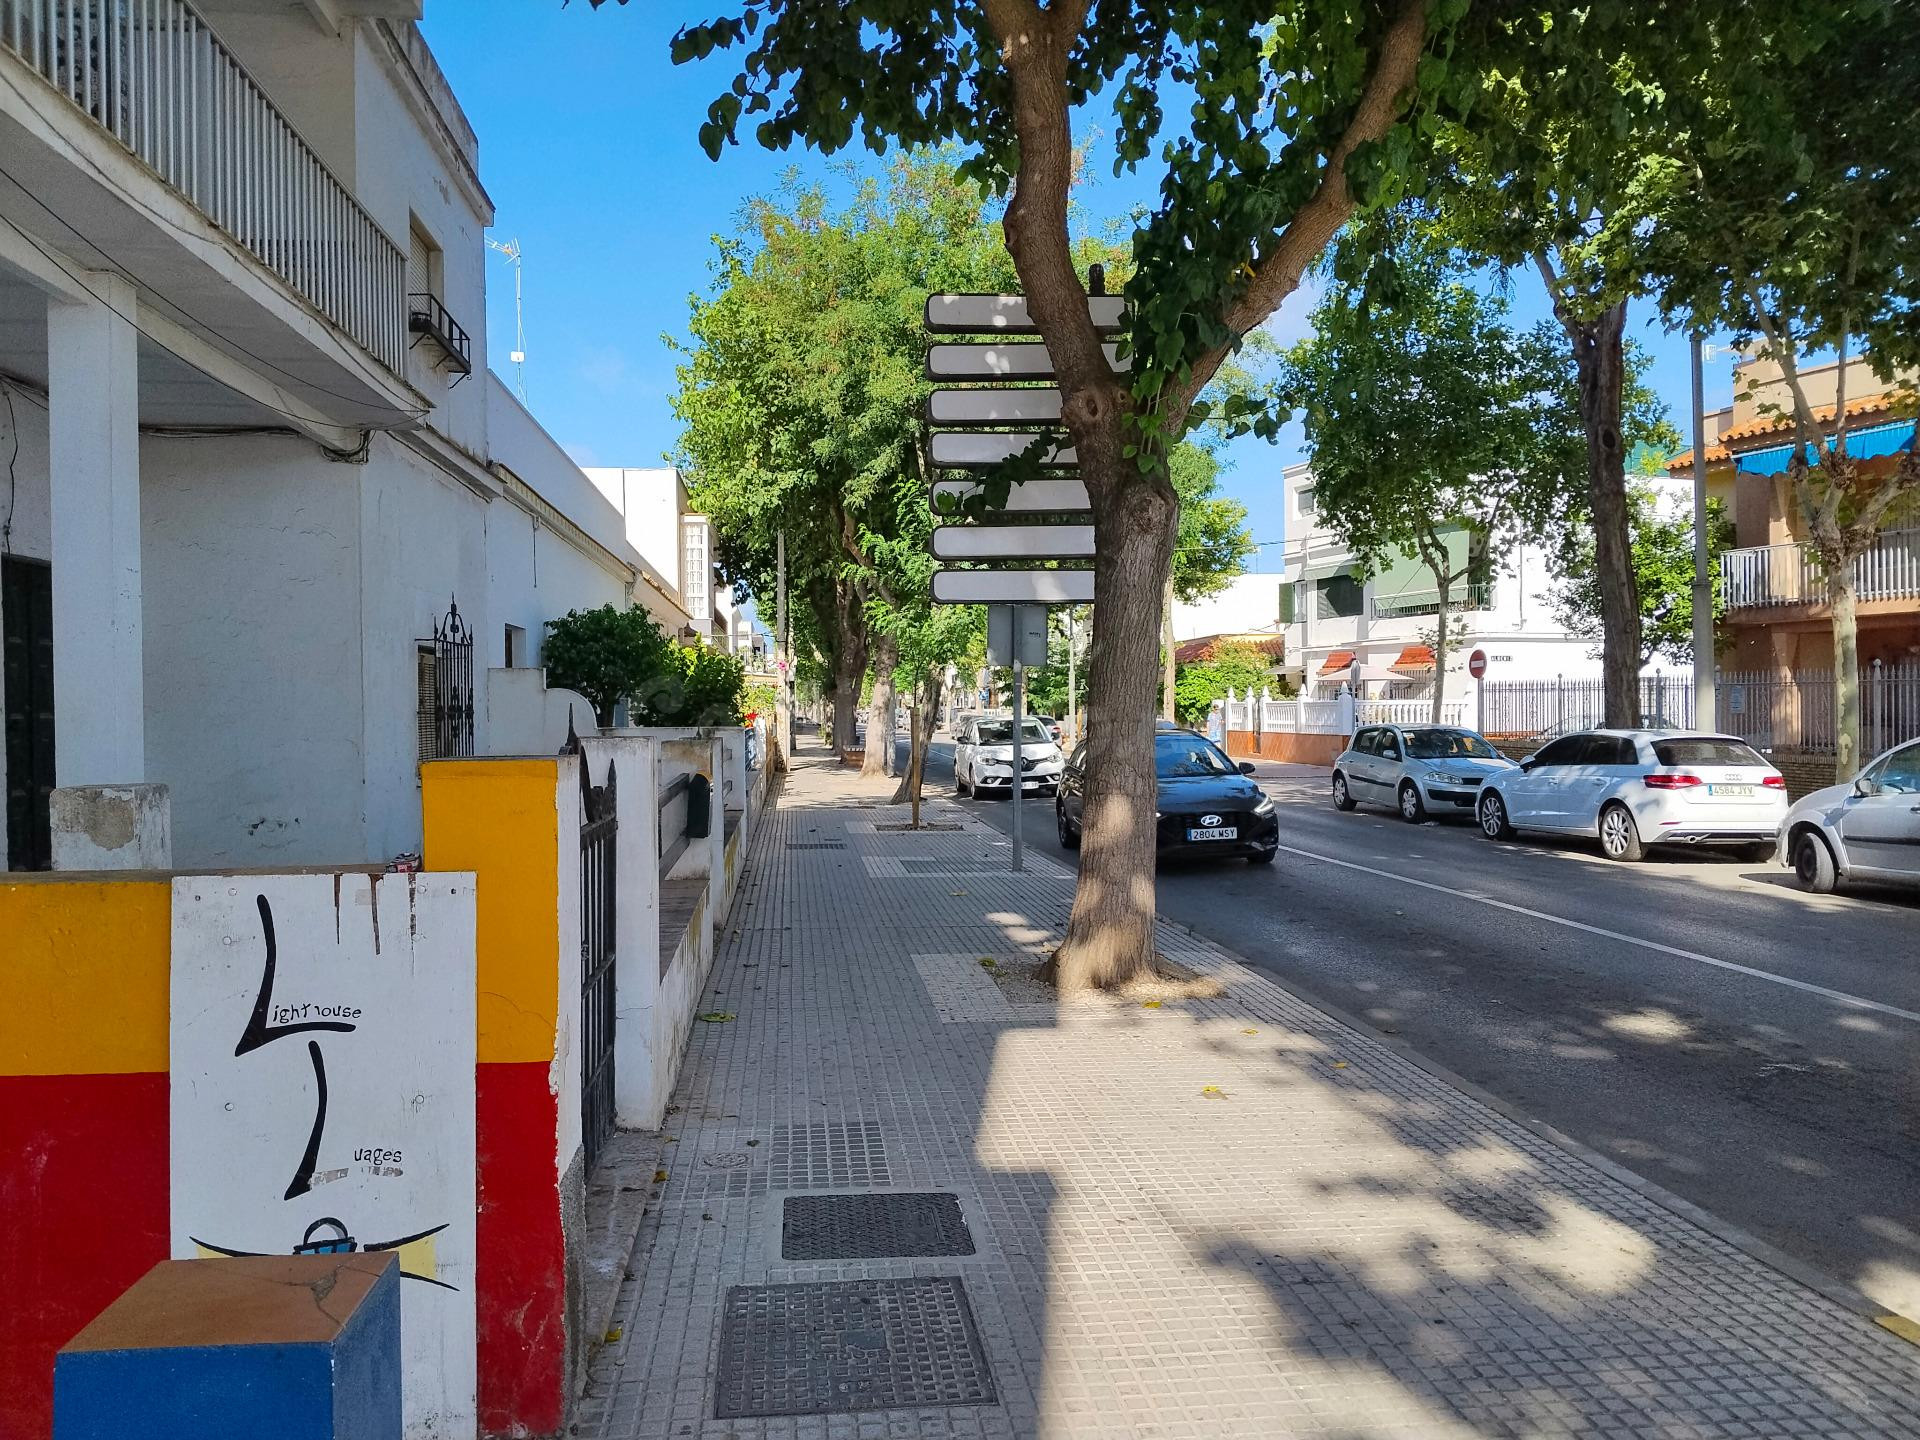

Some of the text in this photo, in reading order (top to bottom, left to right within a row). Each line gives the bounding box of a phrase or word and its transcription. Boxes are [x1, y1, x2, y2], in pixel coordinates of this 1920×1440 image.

[1714, 786, 1753, 795] 4584 JYV
[1193, 830, 1216, 839] 2804
